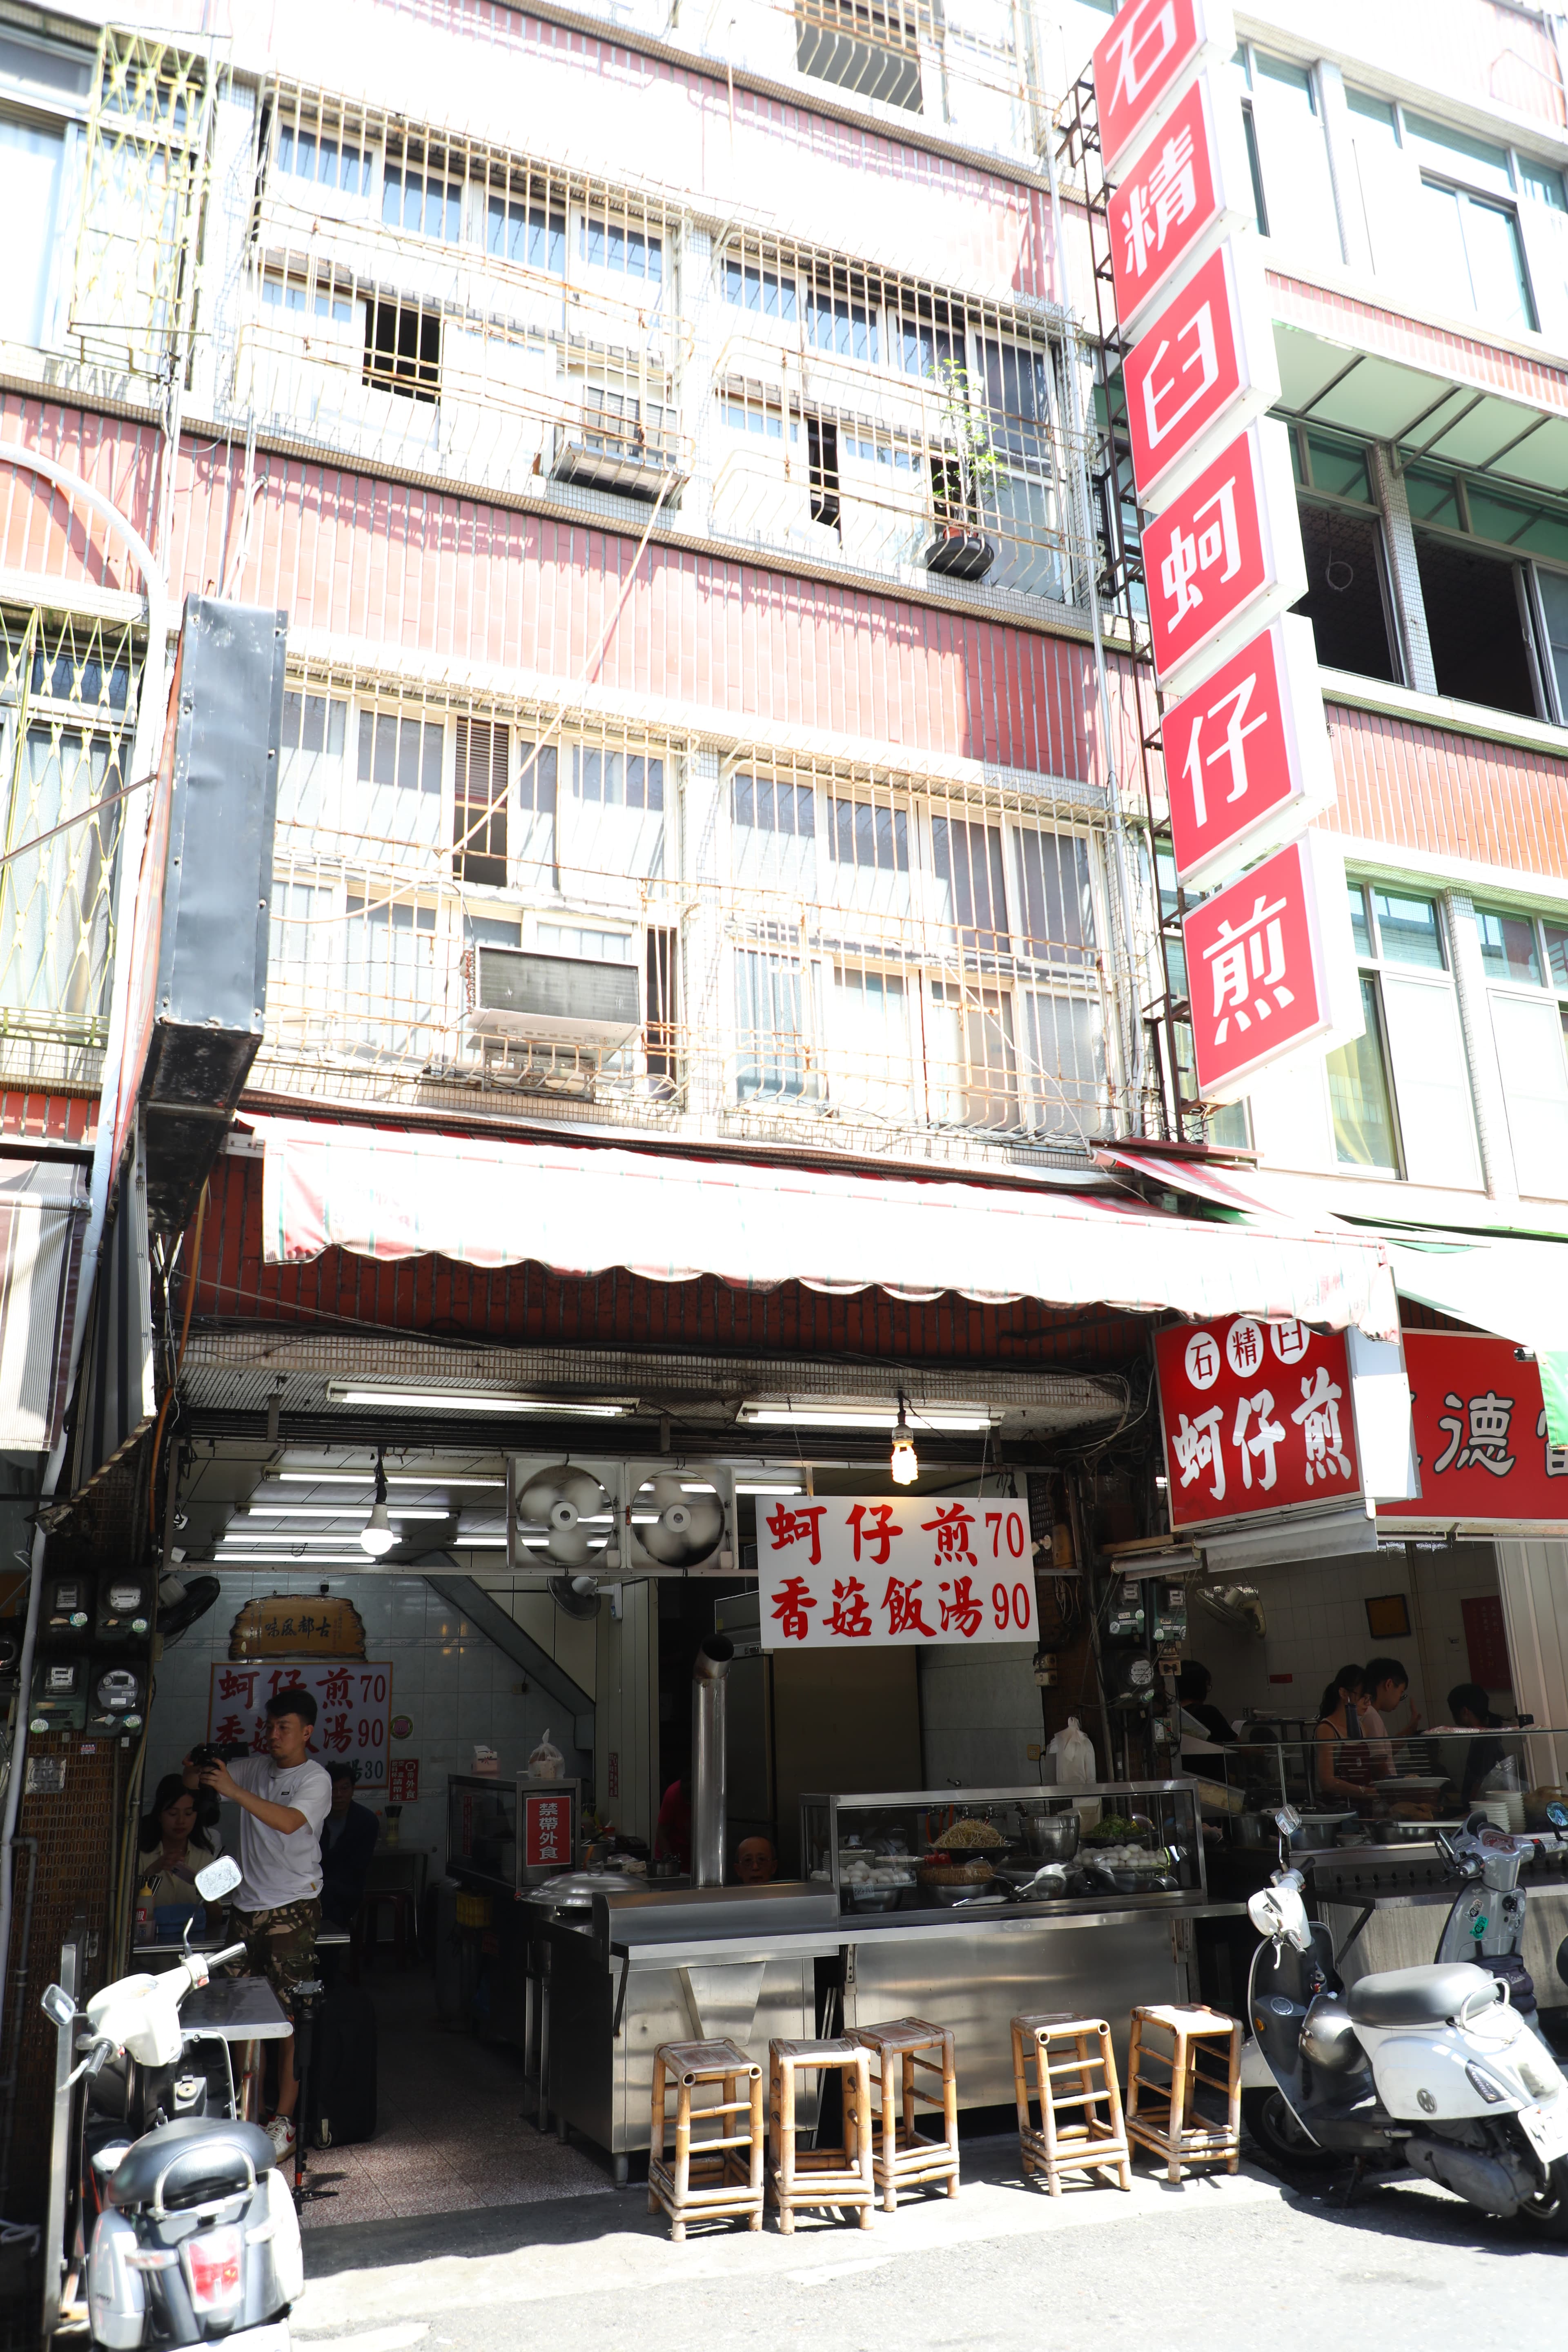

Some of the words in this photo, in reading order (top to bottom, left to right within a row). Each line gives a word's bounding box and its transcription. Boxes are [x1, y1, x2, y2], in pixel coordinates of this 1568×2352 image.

[1105, 0, 1289, 1046] 石精臼蚵仔煎
[1172, 1366, 1352, 1501] 蚵仔煎
[766, 1502, 978, 1567] 蚵仔煎
[985, 1512, 1025, 1558] 70
[770, 1575, 984, 1641] 香菇飯湯
[991, 1583, 1030, 1630] 90
[359, 1675, 386, 1703] 70
[215, 1713, 354, 1753] 香湯
[358, 1719, 384, 1747] 90
[365, 1760, 383, 1779] 30
[539, 1802, 559, 1861] 禁帶外食
